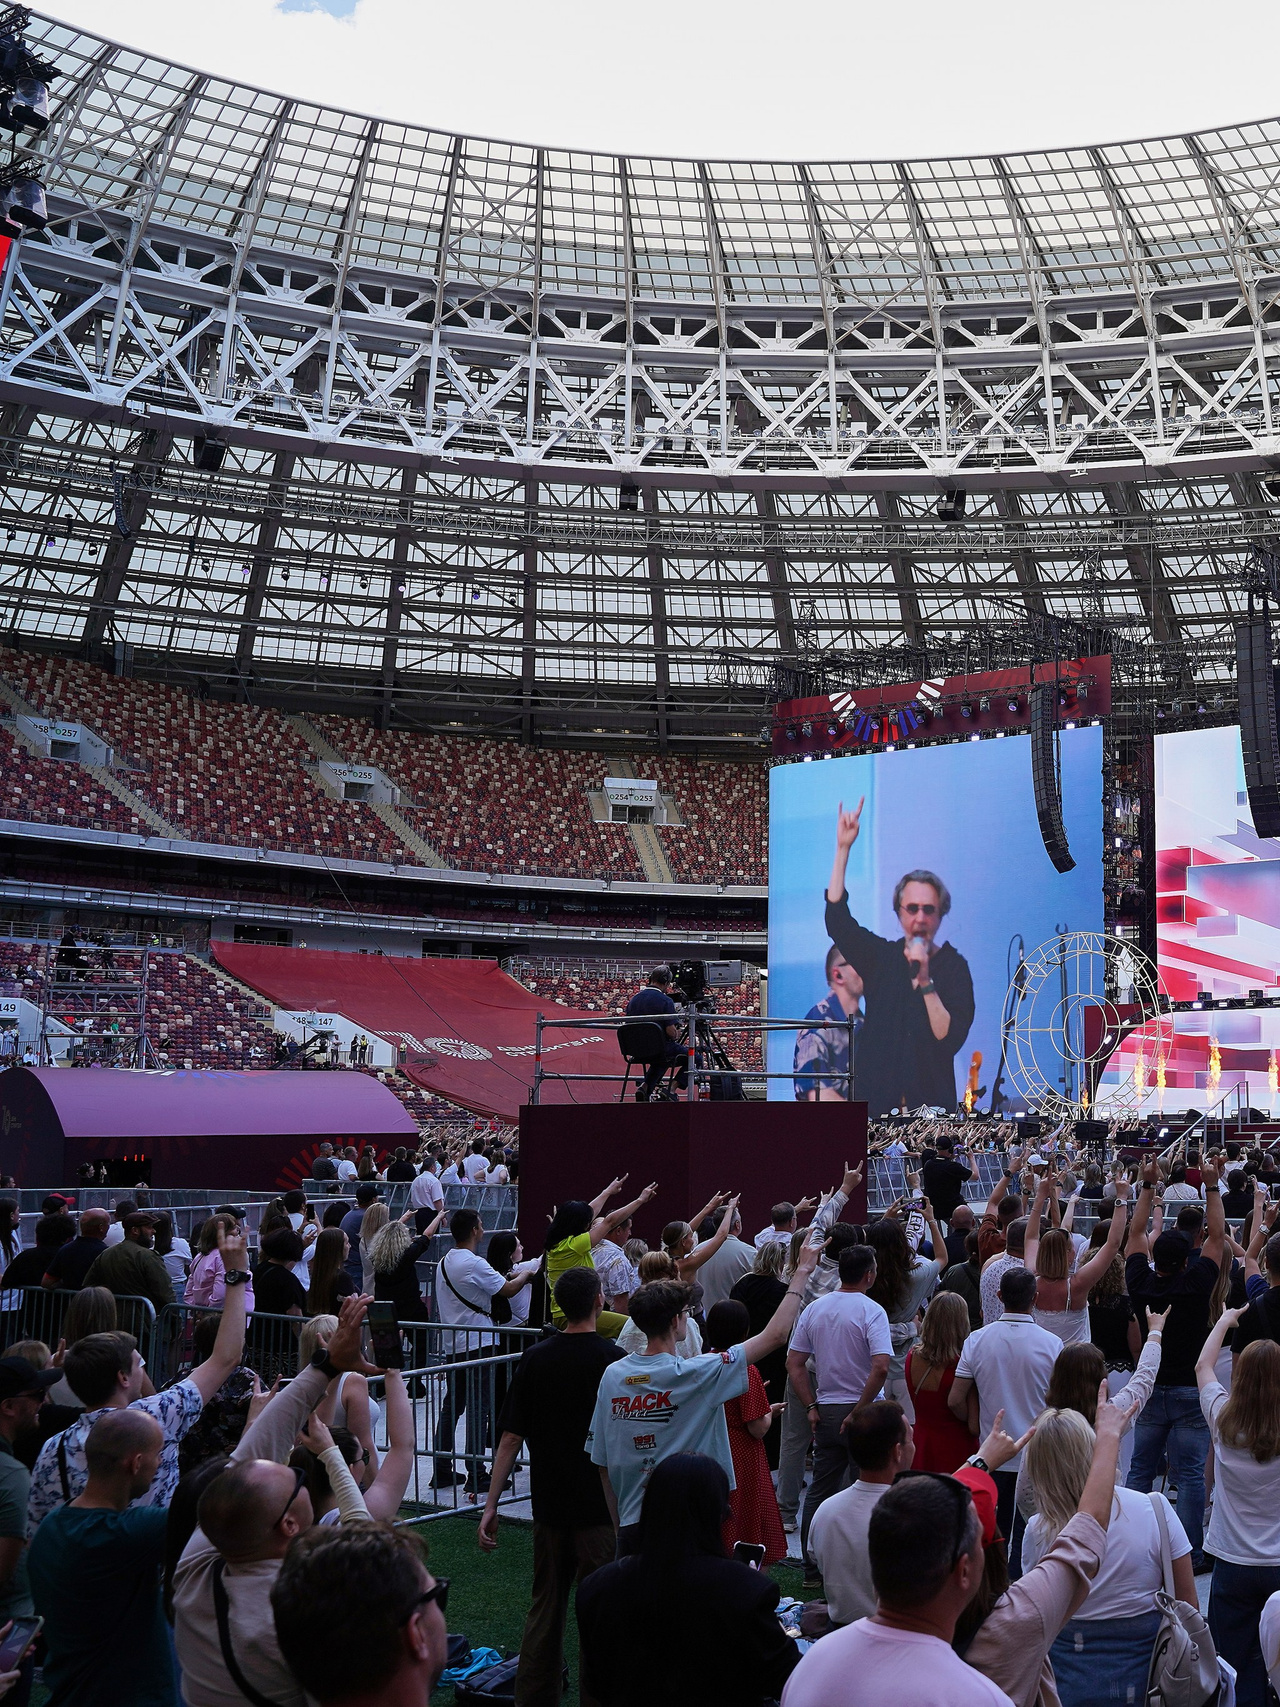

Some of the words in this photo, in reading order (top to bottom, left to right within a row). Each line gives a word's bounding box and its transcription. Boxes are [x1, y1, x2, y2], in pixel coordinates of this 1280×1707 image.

[61, 729, 78, 738] 257
[358, 771, 373, 779] 255
[611, 1390, 673, 1414] TRACK
